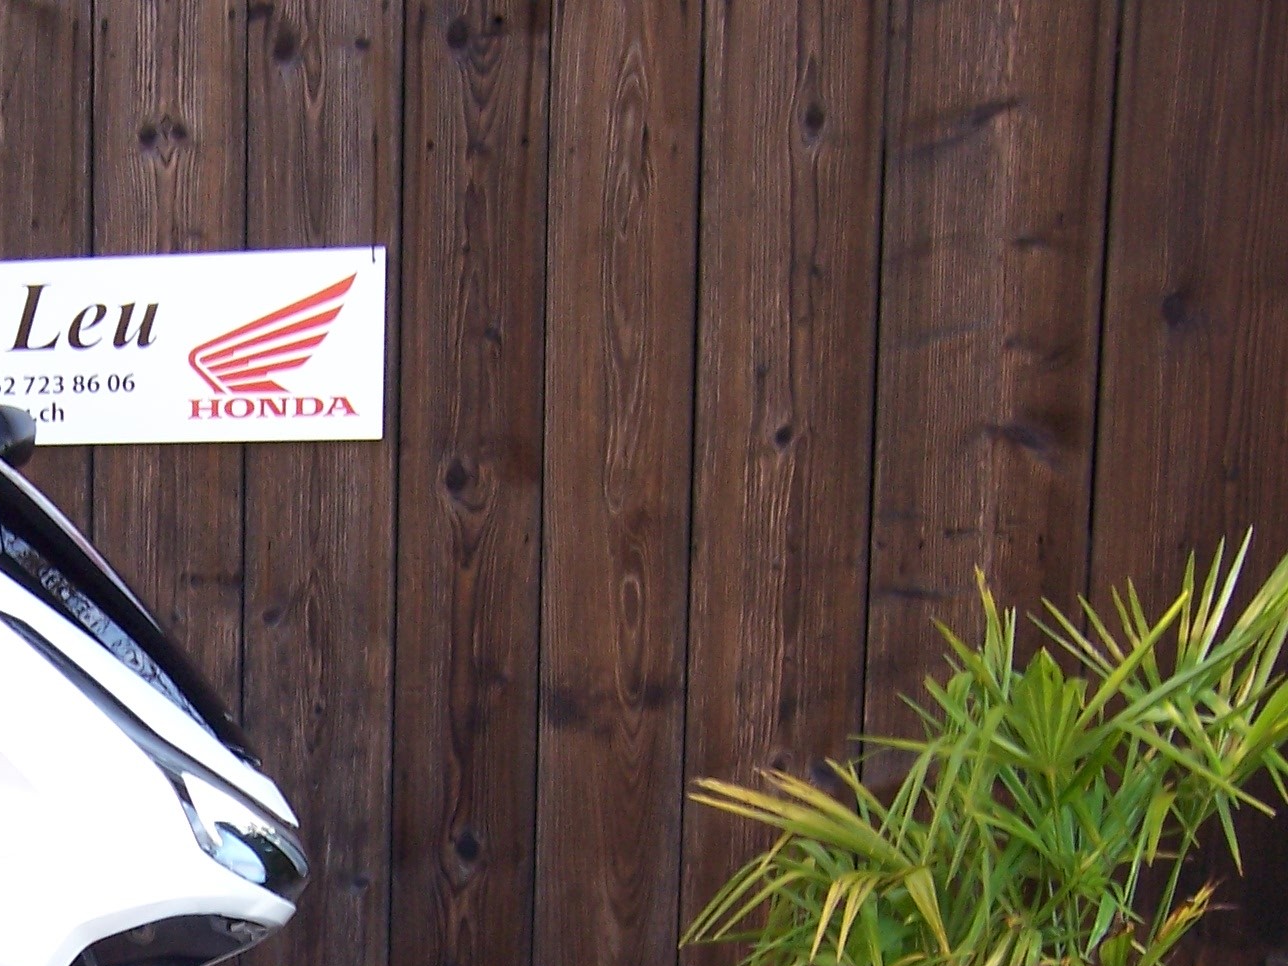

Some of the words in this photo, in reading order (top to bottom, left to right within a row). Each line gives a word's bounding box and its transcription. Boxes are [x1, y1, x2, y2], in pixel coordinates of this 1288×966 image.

[6, 283, 160, 353] Leu
[24, 375, 65, 395] 723
[72, 375, 100, 394] 86
[107, 373, 137, 393] 06
[188, 396, 360, 420] HONDA
